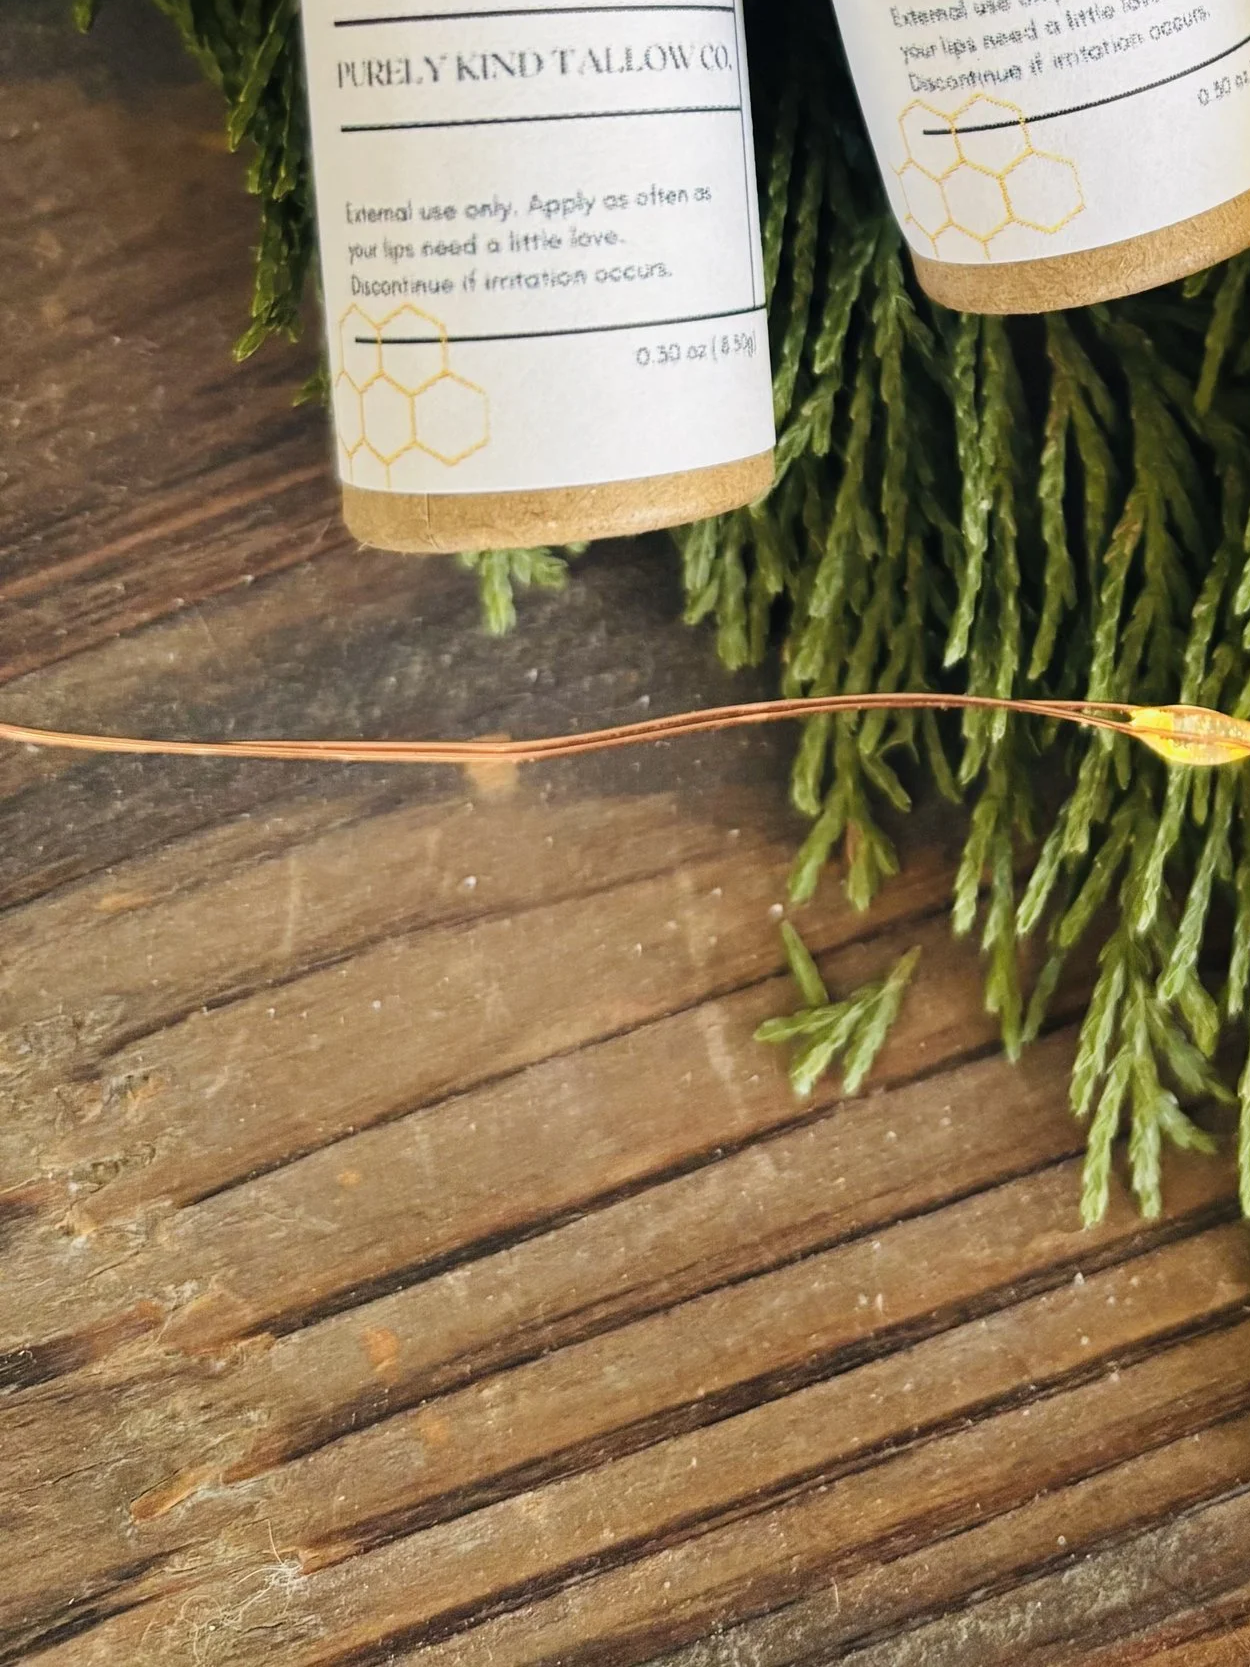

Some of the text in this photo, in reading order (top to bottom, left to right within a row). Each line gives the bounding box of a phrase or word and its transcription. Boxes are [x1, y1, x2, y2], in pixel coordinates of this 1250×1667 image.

[900, 43, 938, 65] your
[943, 34, 978, 59] lips
[982, 18, 1039, 49] need
[1043, 16, 1061, 36] a
[1066, 4, 1116, 32] little
[907, 6, 1210, 95] Discontinue if irritation occurs.
[336, 43, 733, 90] PURELY KIND TALLOW CO.
[345, 183, 711, 224] External use only. Apply as often as
[347, 226, 625, 264] your lips need a little love.
[350, 260, 673, 297] Discontinue if irritation occurs.
[687, 345, 706, 359] oz
